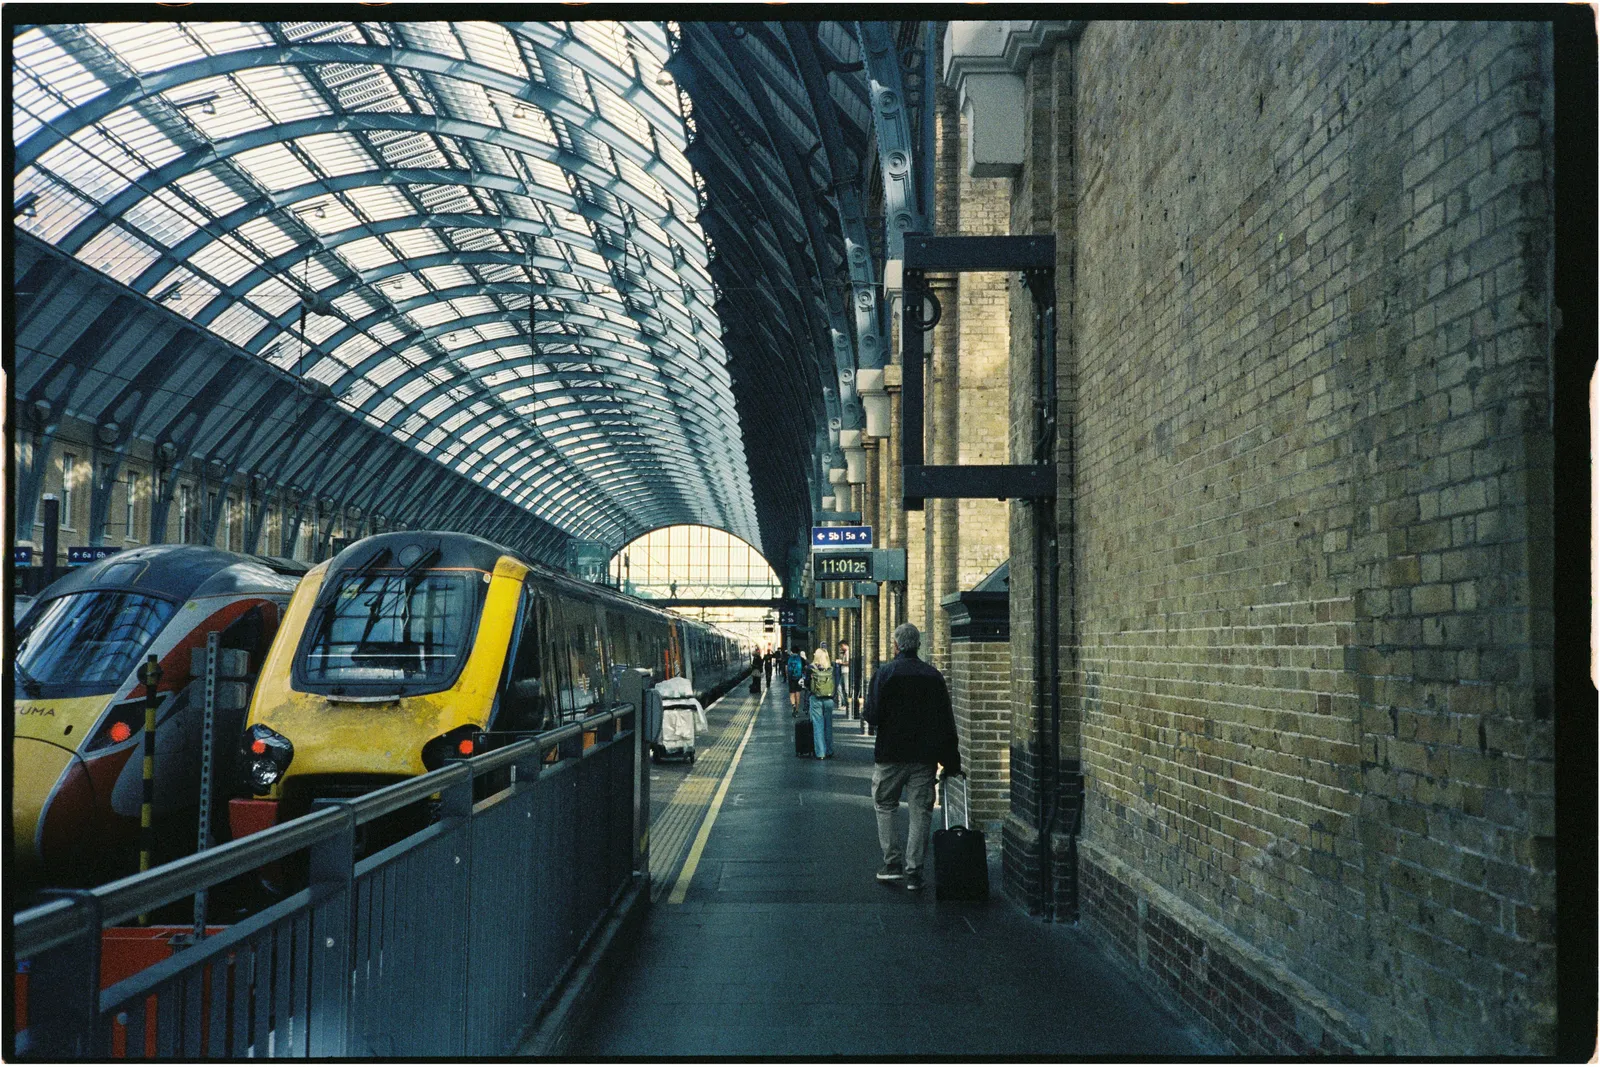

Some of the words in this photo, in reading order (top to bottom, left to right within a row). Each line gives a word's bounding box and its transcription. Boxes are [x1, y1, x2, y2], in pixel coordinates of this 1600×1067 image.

[828, 532, 840, 540] 5b
[845, 531, 856, 540] 5a
[821, 559, 853, 573] 11:01
[15, 705, 55, 716] UMA
